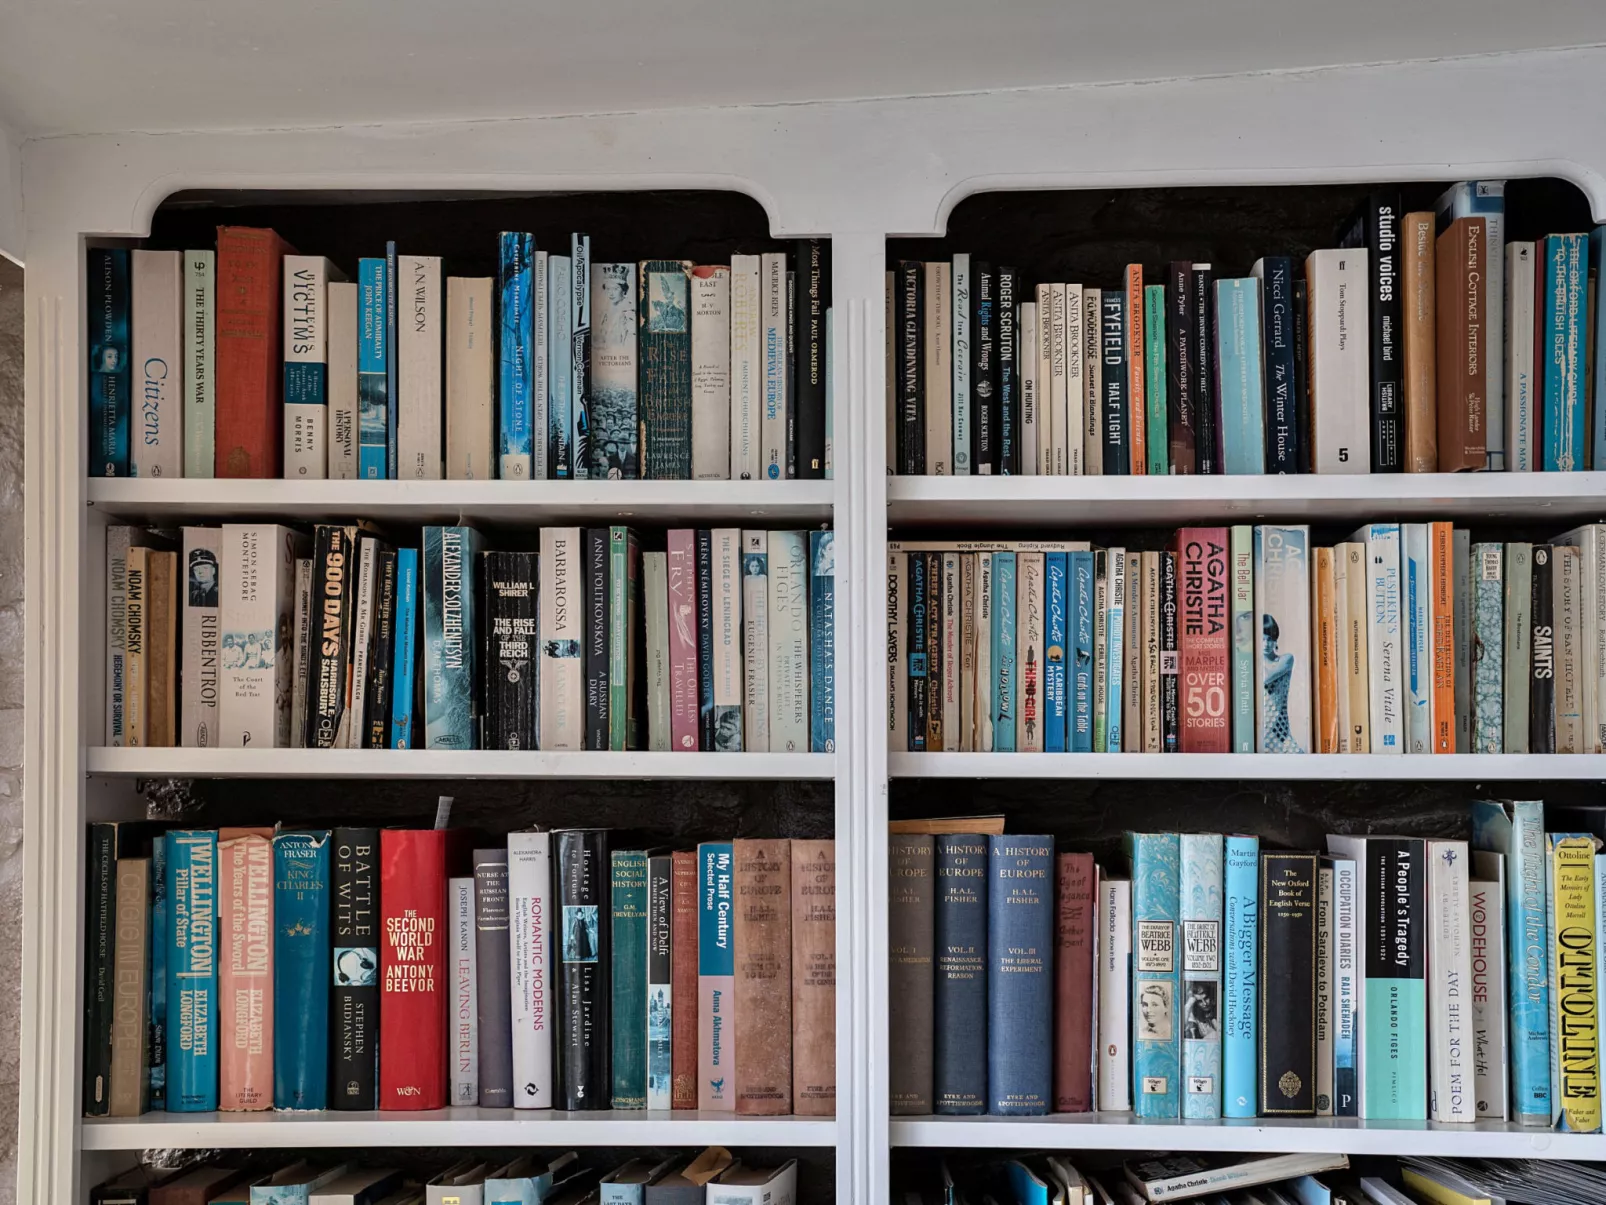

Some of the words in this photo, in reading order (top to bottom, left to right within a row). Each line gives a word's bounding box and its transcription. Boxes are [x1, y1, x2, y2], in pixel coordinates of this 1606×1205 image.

[1379, 207, 1396, 250] studio
[811, 246, 820, 267] Most
[1468, 226, 1479, 268] ENGLISH
[810, 269, 820, 298] Things
[906, 269, 916, 318] VICTORIA
[1000, 275, 1011, 308] ROGER
[1273, 270, 1284, 299] Nicci
[1380, 256, 1394, 301] voices
[812, 300, 820, 315] Fail
[1070, 292, 1079, 323] ANITA
[1468, 272, 1479, 320] COTTAGE
[1000, 312, 1012, 360] SCRUTON
[1105, 304, 1121, 364] FYFIELD
[1273, 304, 1285, 347] Gerrard
[1383, 316, 1392, 344] michael
[768, 328, 776, 378] MEDIEVAL
[906, 321, 916, 392] GLENDINNING
[1071, 326, 1079, 378] BROOKNER
[1383, 346, 1392, 360] bird
[1469, 324, 1478, 375] INTERIORS
[1025, 380, 1032, 390] ON
[1275, 364, 1285, 380] The
[142, 358, 168, 446] Citizens
[768, 380, 776, 419] EUROPE
[906, 398, 916, 422] VITA
[1109, 383, 1119, 408] HALF
[1276, 383, 1287, 421] Winter
[294, 416, 302, 453] MORRIS
[1109, 414, 1120, 444] LIGHT
[1277, 426, 1288, 460] House
[1339, 449, 1348, 462] 5
[331, 531, 339, 550] THE
[594, 538, 603, 569] ANNA
[722, 537, 730, 553] THE
[325, 553, 343, 596] 900
[444, 533, 461, 592] ALEXANDER
[1115, 553, 1123, 576] AGATHA
[1238, 553, 1249, 566] The
[129, 570, 141, 600] NOAM
[493, 582, 527, 590] WILLIAM
[556, 540, 566, 631] BARBAROSSA
[723, 582, 730, 594] OF
[1114, 579, 1123, 605] CHRISTIE
[1186, 541, 1203, 635] CHRISTIE
[1207, 541, 1224, 635] AGATHA
[1238, 569, 1249, 584] Bell
[1238, 588, 1249, 601] Jar
[1376, 578, 1386, 624] BUTTON
[1386, 568, 1397, 634] PUSHKIN'S
[128, 604, 141, 654] CHOMSKY
[322, 599, 341, 656] DAYS
[594, 573, 603, 656] POLITKOVSKAYA
[723, 597, 731, 645] LENINGRAD
[445, 595, 462, 668] SOLZHENITSYN
[824, 593, 832, 670] NATASHA'S
[201, 616, 217, 707] RIBBENTROP
[500, 650, 527, 658] REICH
[1185, 657, 1224, 666] MARPLE
[1383, 642, 1393, 681] Serena
[1533, 626, 1552, 679] SAINTS
[319, 659, 329, 716] SALISBURY
[328, 660, 337, 707] HARRISON
[1047, 666, 1055, 701] MYSTERY
[1187, 673, 1224, 686] OVER
[1240, 660, 1249, 688] Sylvia
[589, 679, 597, 706] DIARY
[824, 676, 833, 723] DANCE
[1186, 686, 1225, 717] 50
[1241, 691, 1249, 714] Plath
[1384, 688, 1394, 723] Vitale
[328, 709, 335, 717] E.
[1187, 718, 1225, 728] STORIES
[284, 850, 317, 858] FRASER
[339, 846, 351, 872] OF
[612, 860, 647, 868] ENGLISH
[706, 853, 715, 885] Selected
[716, 853, 730, 871] My
[1017, 859, 1029, 867] OF
[1231, 849, 1256, 857] Martin
[1398, 851, 1409, 859] A
[1559, 850, 1590, 860] Ottoline
[612, 880, 647, 888] HISTORY
[616, 870, 646, 878] SOCIAL
[718, 874, 730, 899] Half
[1000, 869, 1045, 878] EUROPE
[1396, 863, 1409, 915] People's
[355, 845, 370, 935] BATTLE
[459, 887, 468, 917] JOSEPH
[706, 888, 715, 910] Prose
[1244, 896, 1256, 910] A
[191, 846, 212, 971] WELLINGTON
[247, 845, 268, 970] WELLINGTON
[339, 884, 351, 935] WITS
[404, 910, 417, 918] THE
[386, 917, 435, 932] SECOND
[389, 932, 433, 947] WORLD
[460, 921, 468, 951] KANON
[531, 897, 543, 964] ROMANTIC
[716, 902, 730, 949] Century
[1141, 931, 1171, 939] BEATRICE
[1238, 914, 1255, 966] Bigger
[396, 947, 424, 961] WAR
[1141, 939, 1171, 952] WEBB
[1395, 918, 1409, 966] Tragedy
[386, 965, 434, 979] ANTONY
[386, 979, 434, 993] BEEVOR
[459, 959, 469, 1019] LEAVING
[532, 969, 544, 1031] MODERNS
[713, 990, 721, 1013] Anna
[180, 990, 192, 1050] LONGFORD
[235, 989, 249, 1048] LONGFORD
[1238, 972, 1255, 1039] Message
[1390, 987, 1398, 1028] ORLANDO
[1558, 927, 1596, 1098] OTTOLINE
[194, 990, 207, 1056] ELIZABETH
[249, 989, 262, 1055] ELIZABETH
[343, 996, 352, 1061] BUDIANSKY
[355, 1003, 364, 1054] STEPHEN
[460, 1024, 470, 1072] BERLIN
[712, 1015, 722, 1065] Akhmatova
[1390, 1033, 1398, 1059] FIGES
[1167, 1182, 1187, 1192] Agatha
